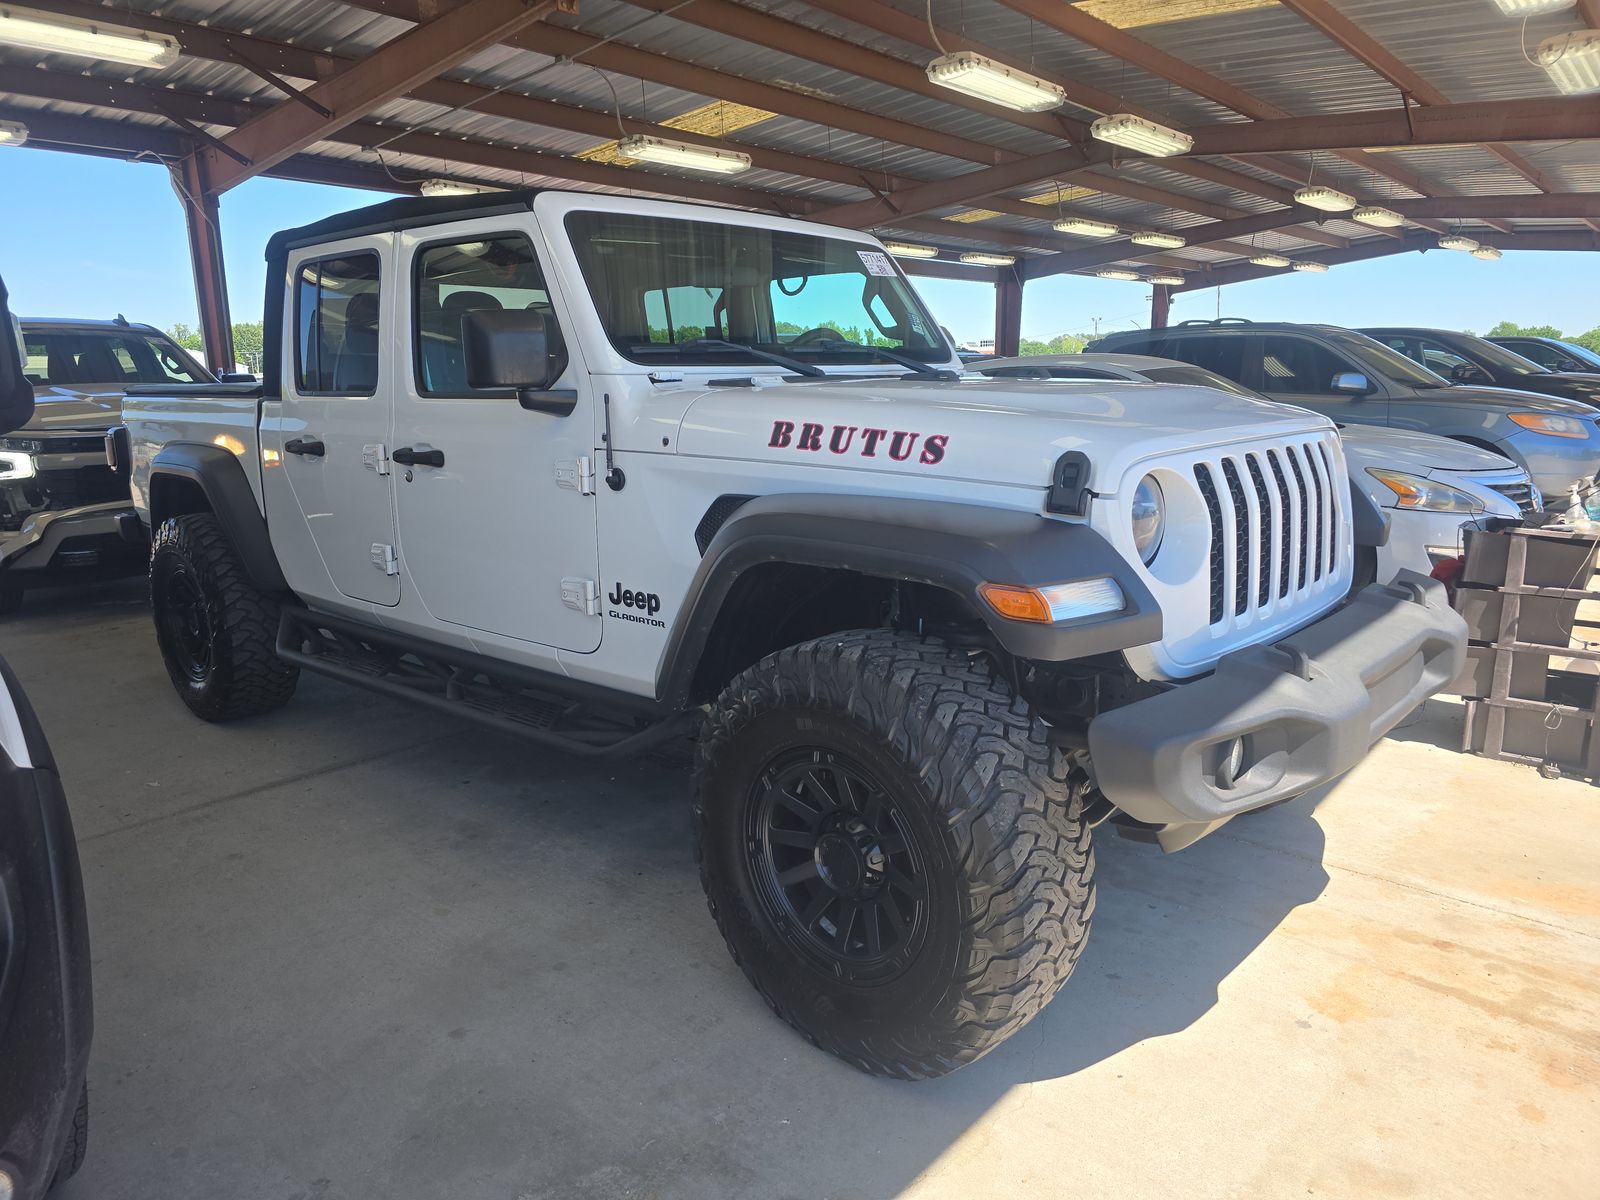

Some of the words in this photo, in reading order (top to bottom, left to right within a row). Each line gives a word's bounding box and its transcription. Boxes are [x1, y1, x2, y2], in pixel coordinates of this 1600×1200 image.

[767, 420, 950, 465] BRUTUS
[608, 581, 661, 617] Jeep
[608, 610, 666, 629] GLADIATOR
